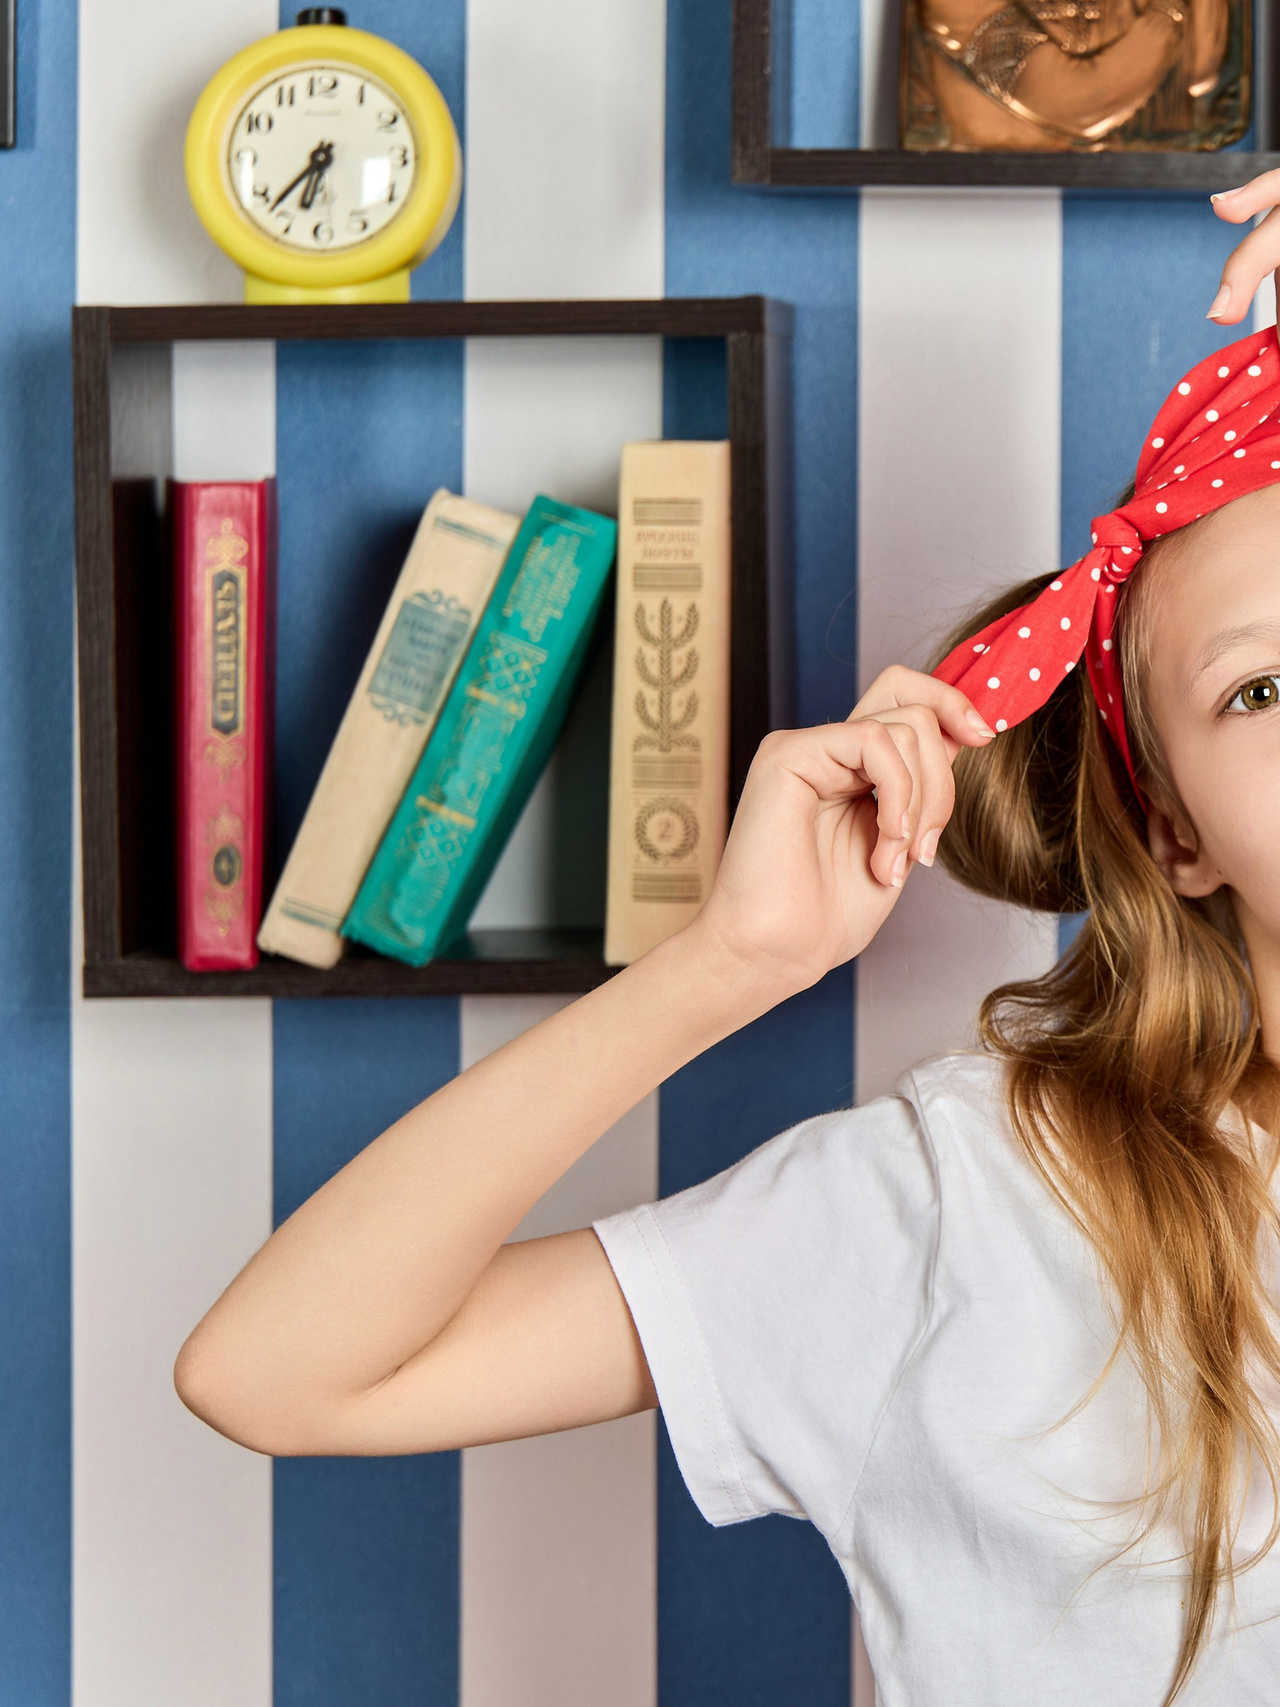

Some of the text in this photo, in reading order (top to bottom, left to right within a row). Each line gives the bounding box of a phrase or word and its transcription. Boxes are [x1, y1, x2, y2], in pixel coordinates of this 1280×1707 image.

[277, 85, 295, 106] 11
[308, 75, 338, 98] 12
[357, 84, 366, 105] 1
[247, 112, 273, 134] 10
[377, 109, 398, 132] 2
[390, 146, 408, 168] 3
[276, 211, 295, 234] 7
[349, 210, 368, 232] 5
[313, 222, 334, 245] 6
